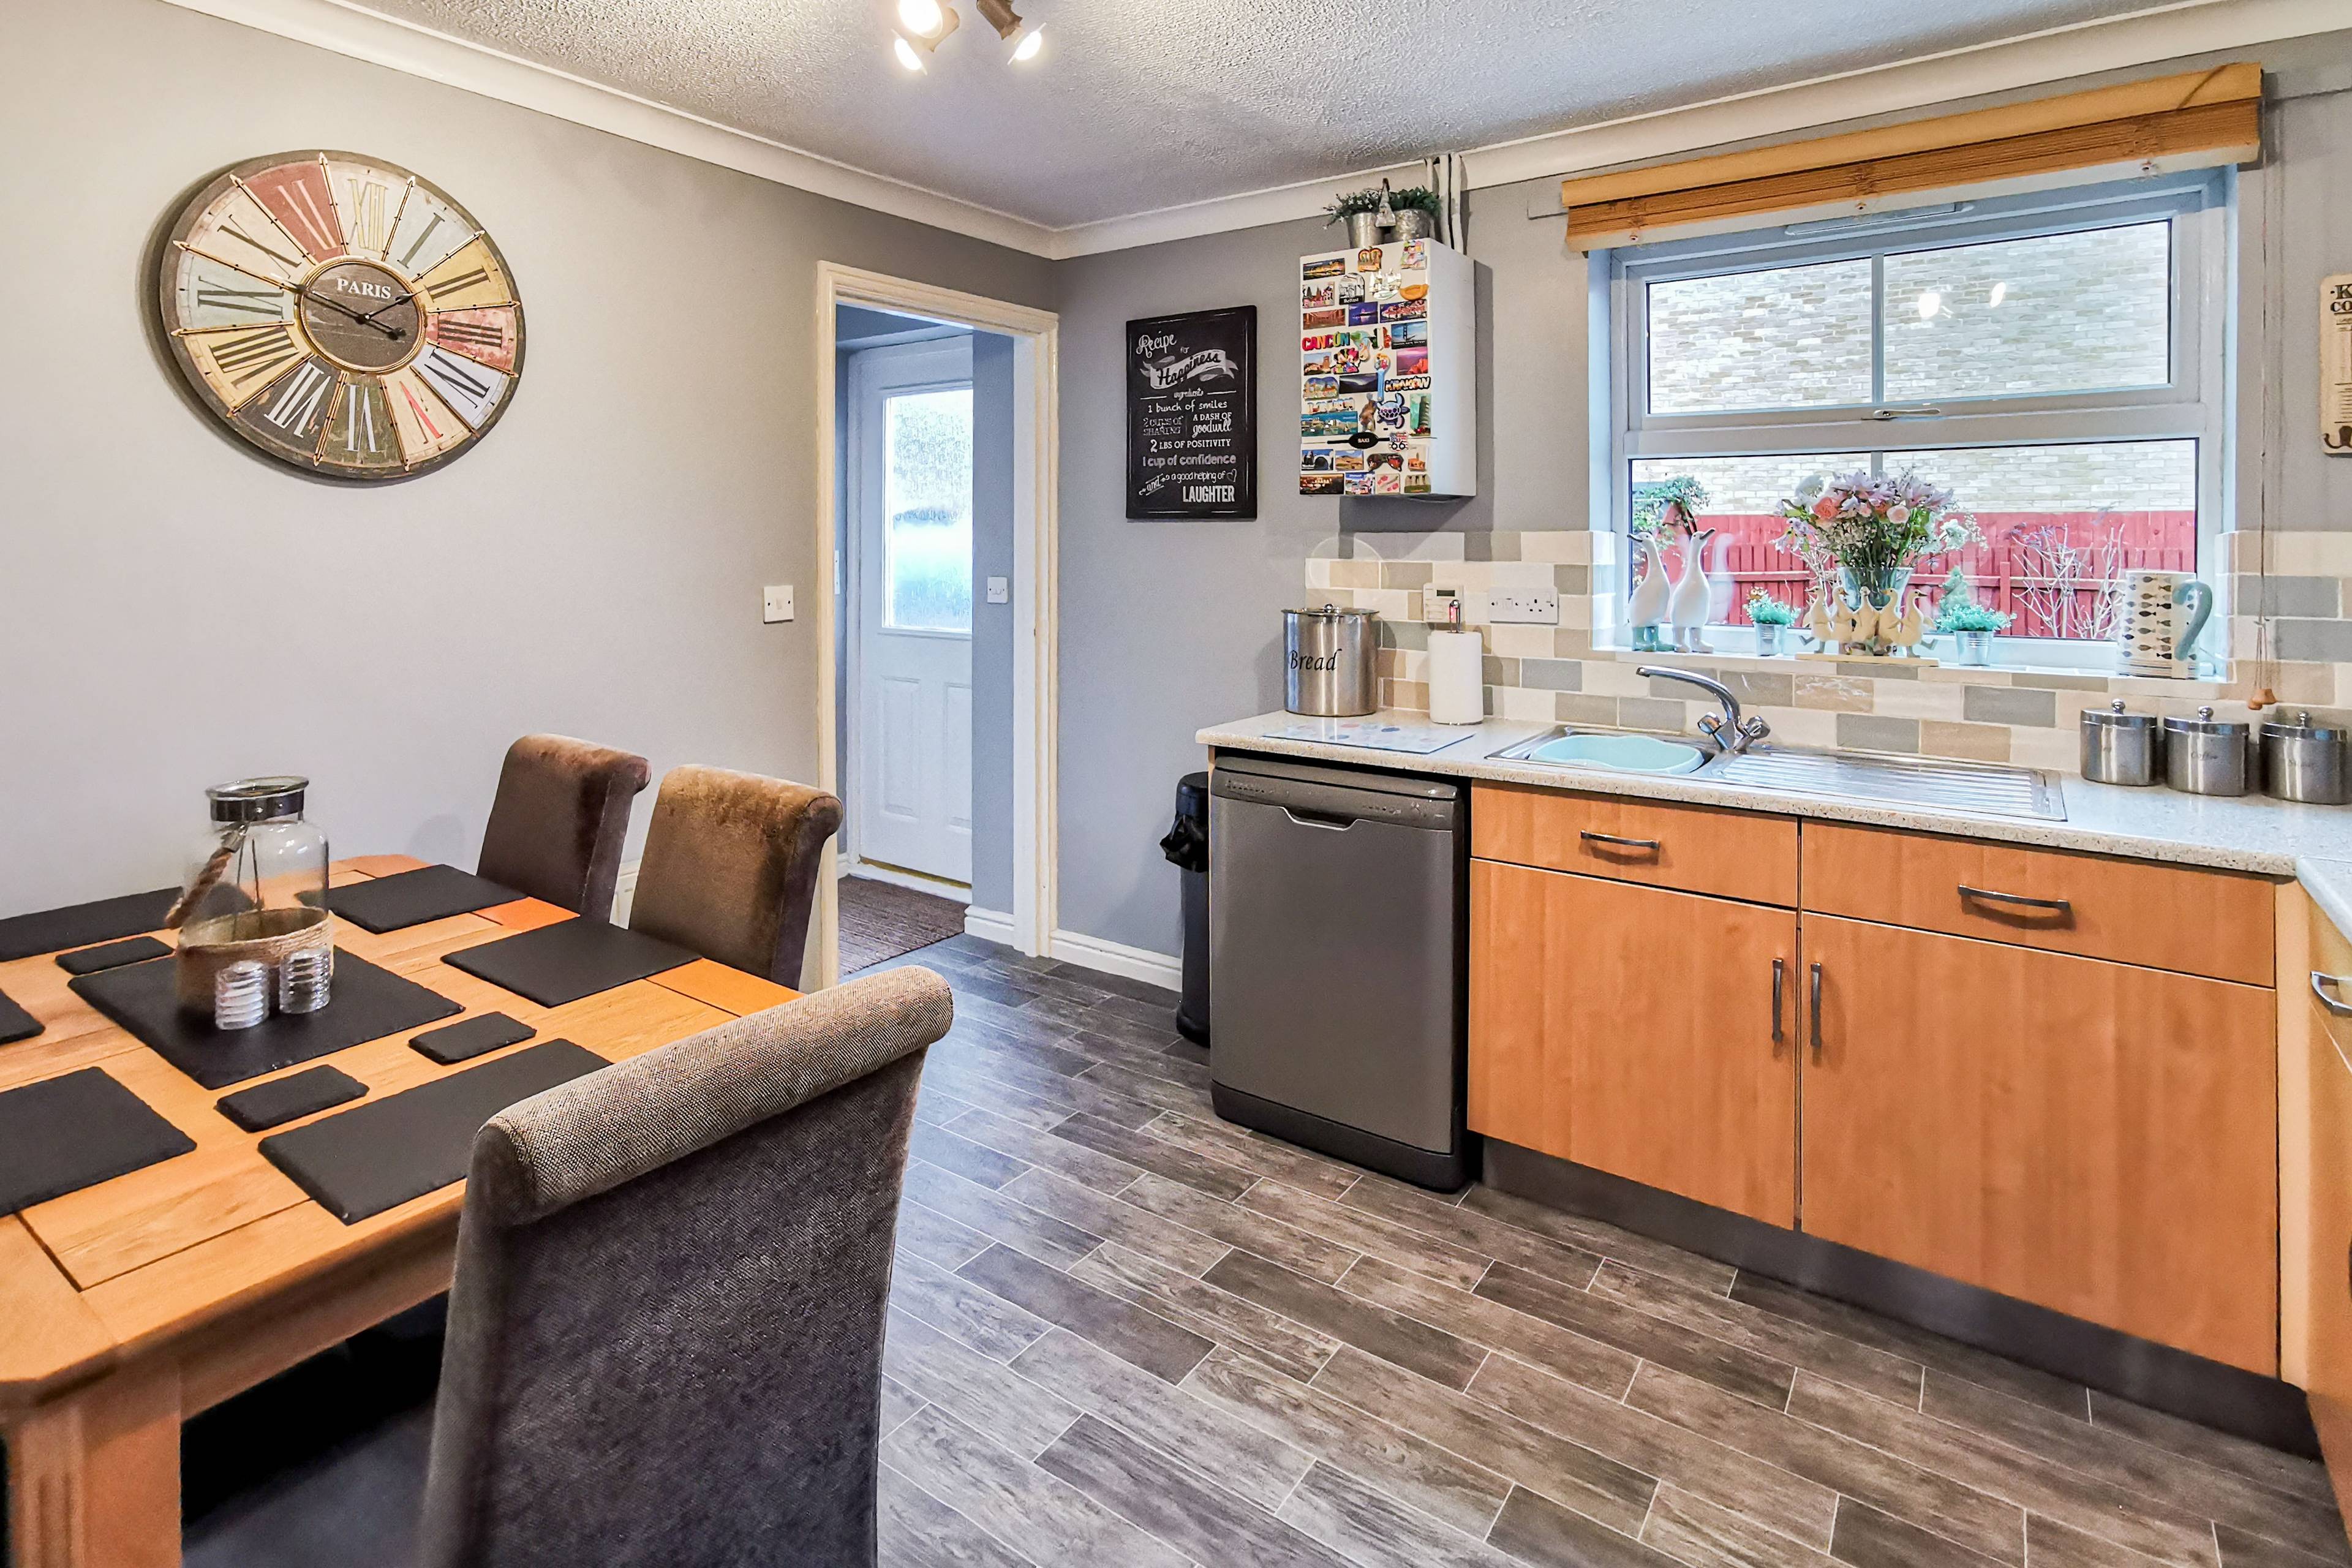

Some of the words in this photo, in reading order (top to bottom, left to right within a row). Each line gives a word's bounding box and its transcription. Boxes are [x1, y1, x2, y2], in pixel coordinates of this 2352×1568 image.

[347, 179, 388, 253] XII
[217, 214, 302, 279] X
[198, 276, 284, 319] IX
[336, 277, 391, 300] PARIS
[424, 265, 491, 303] II
[437, 315, 502, 348] III
[1136, 331, 1177, 358] Recipe
[208, 326, 300, 389] VIII
[1156, 353, 1221, 386] Happiness
[424, 349, 490, 409] IV
[264, 361, 331, 438] VII
[399, 381, 443, 444] V
[1156, 402, 1182, 412] bunch
[1185, 399, 1196, 412] of
[1199, 400, 1227, 409] smiles
[344, 384, 385, 452] VI
[1192, 419, 1232, 438] goodwill
[1147, 458, 1166, 468] cup
[1167, 454, 1177, 466] of
[1180, 454, 1236, 466] confidence
[1150, 439, 1158, 453] 2
[1187, 439, 1231, 448] POSITIVITY
[1147, 475, 1161, 491] and
[1177, 472, 1193, 483] good
[1217, 470, 1226, 479] of
[1183, 485, 1235, 502] LAUGHTER
[1288, 649, 1342, 671] Bread
